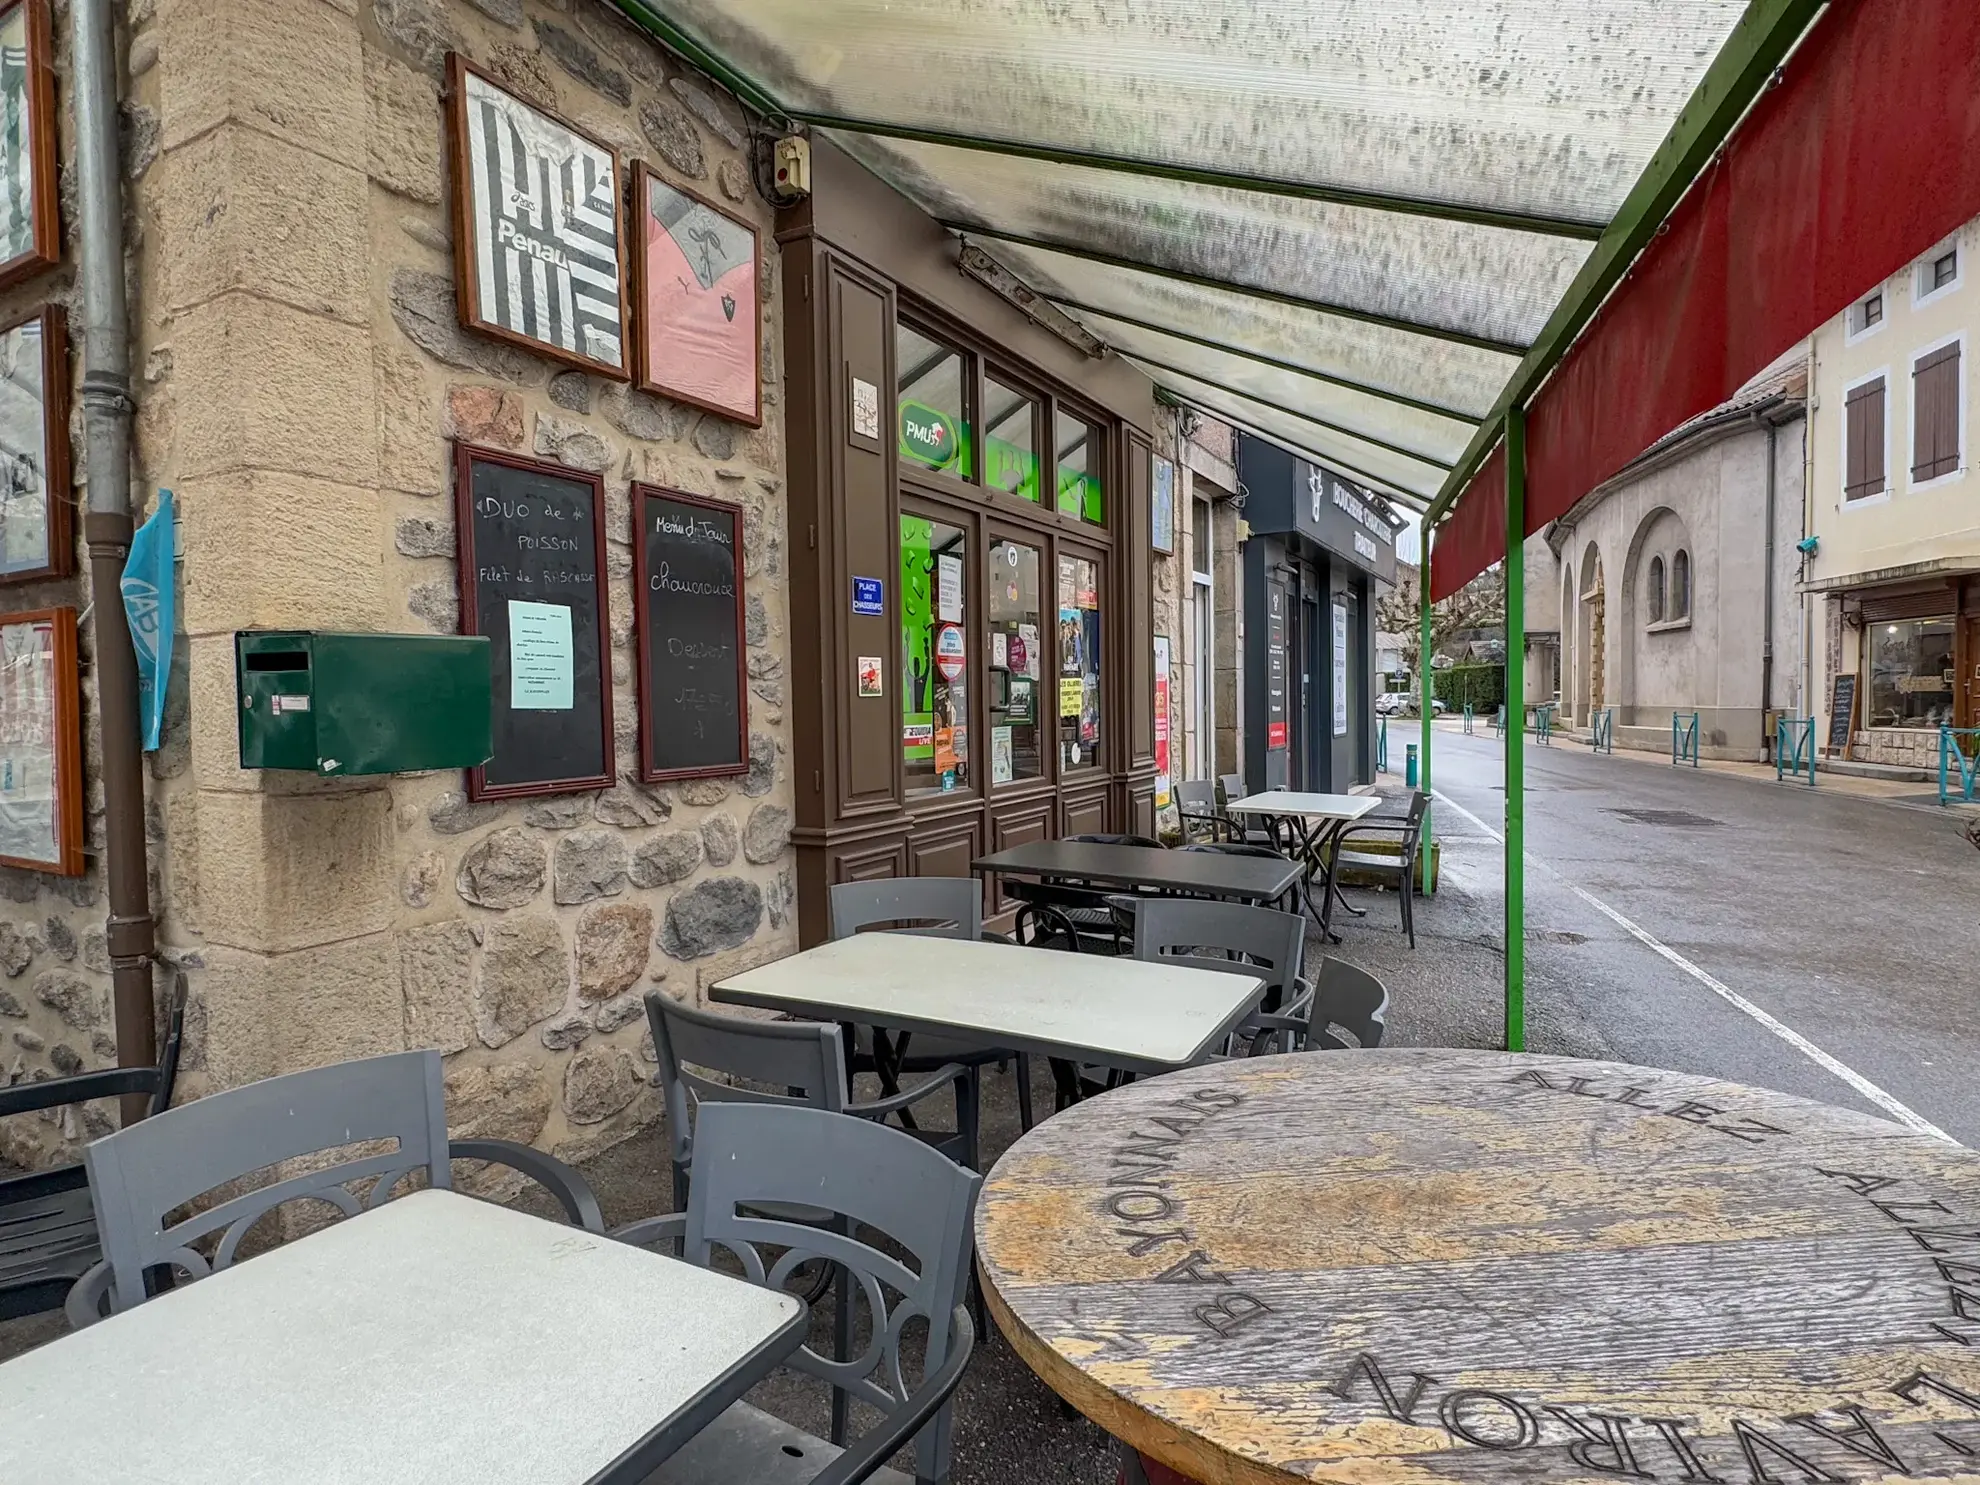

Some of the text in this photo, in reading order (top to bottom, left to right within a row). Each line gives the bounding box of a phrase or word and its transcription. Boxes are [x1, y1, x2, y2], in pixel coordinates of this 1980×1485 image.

[498, 217, 569, 271] Penau
[906, 420, 931, 444] PMU
[484, 497, 564, 519] DUO de
[656, 516, 684, 535] Menu
[697, 521, 732, 543] Jour
[518, 533, 578, 550] POISSON
[480, 565, 510, 582] Filet
[516, 569, 532, 582] de
[859, 582, 877, 592] PLACE
[854, 600, 883, 610] CHASSEURS
[1503, 1070, 1791, 1143] ALLEZ
[1106, 1088, 1274, 1338] BAYONNAIS
